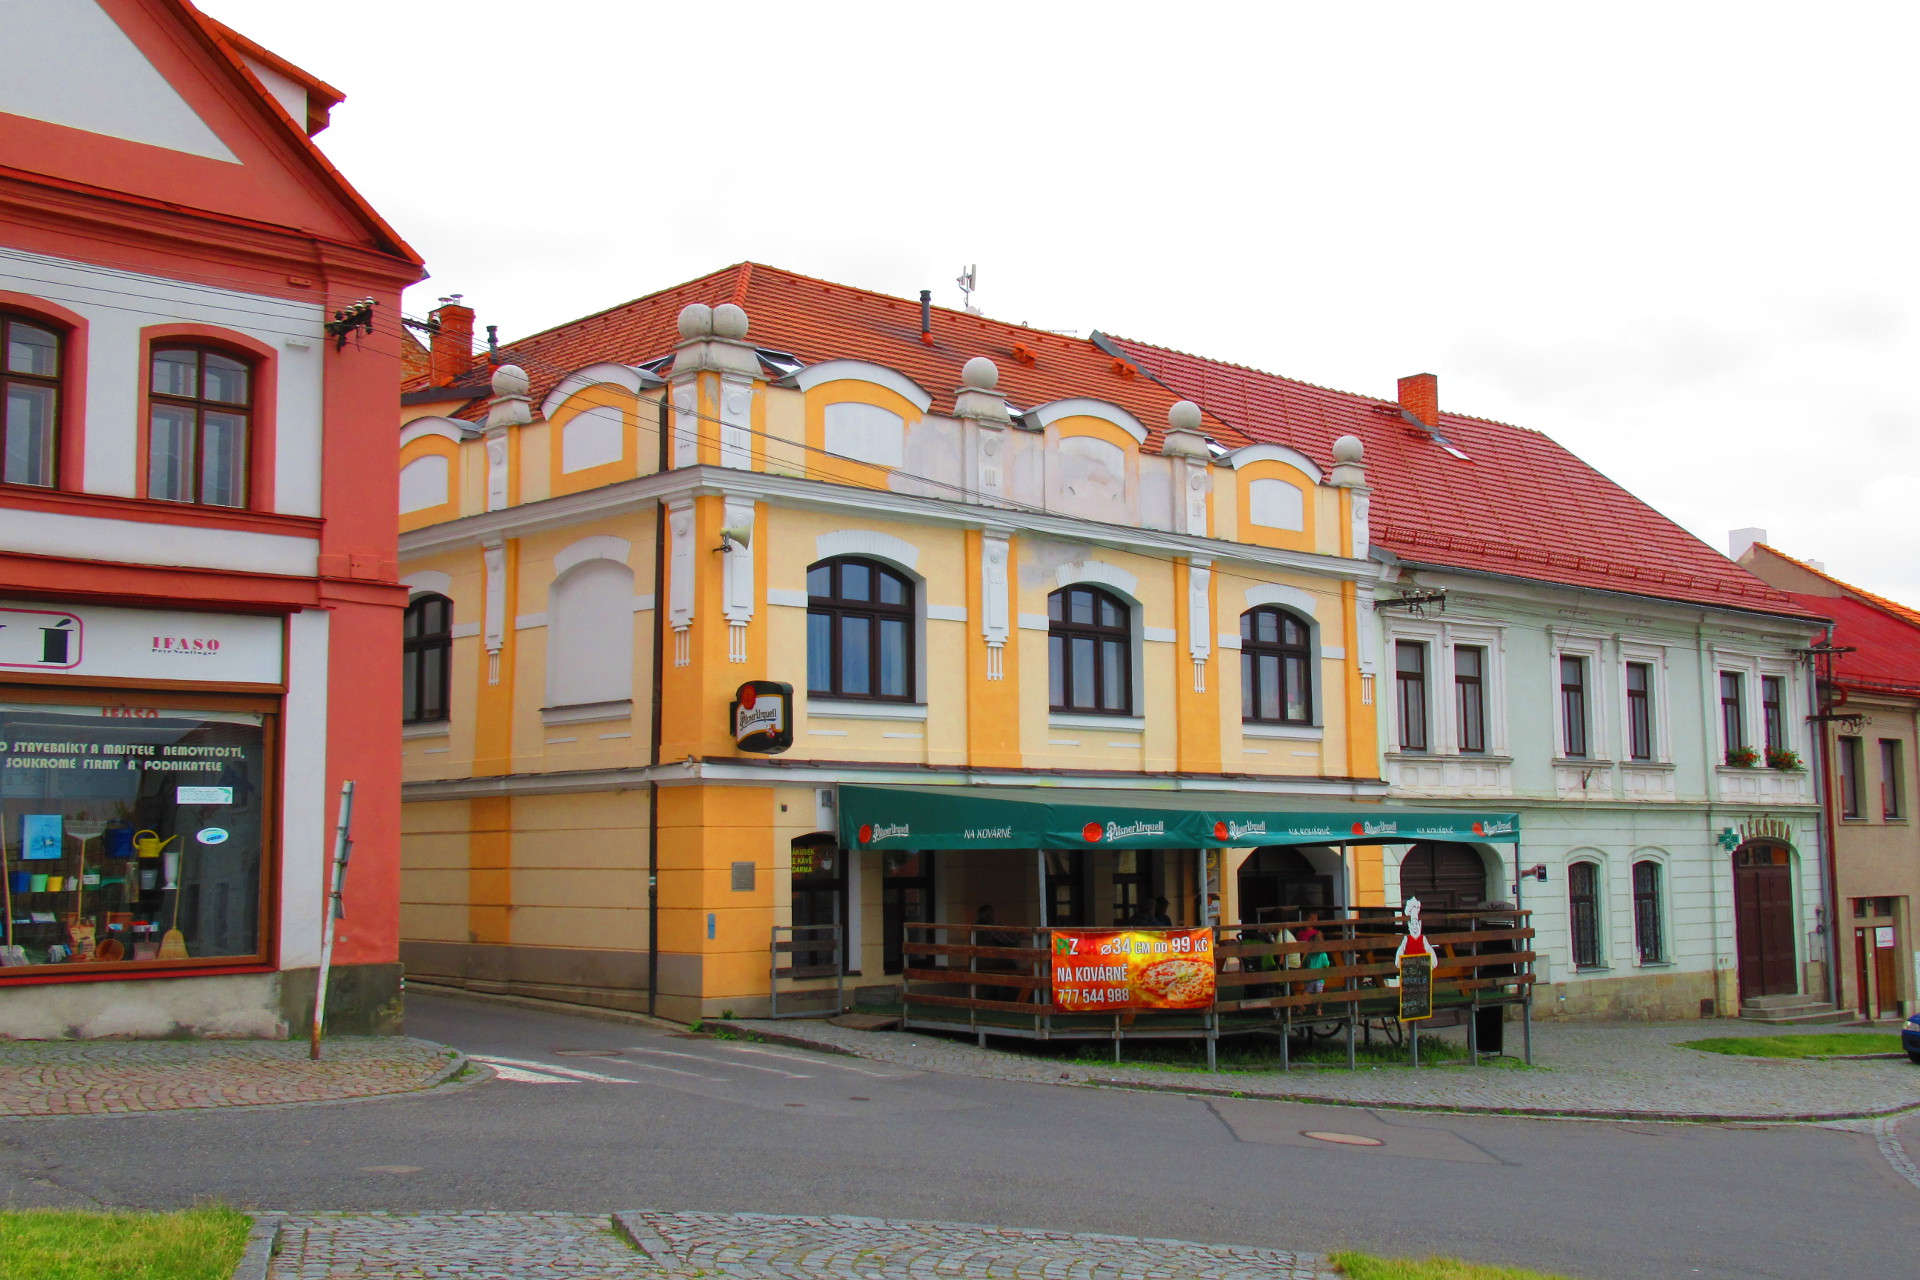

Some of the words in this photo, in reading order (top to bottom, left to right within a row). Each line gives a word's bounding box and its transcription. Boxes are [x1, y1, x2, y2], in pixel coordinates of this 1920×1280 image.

[152, 637, 220, 651] IFASO
[739, 711, 756, 731] Pilsner
[755, 708, 777, 723] Urquell
[13, 741, 88, 753] STAVEBNÍKY
[90, 743, 99, 754] A
[103, 743, 155, 756] MAJITELE
[6, 757, 76, 768] SOUKROMÉ
[83, 759, 120, 769] FIRMY
[128, 760, 136, 770] A
[144, 760, 223, 772] PODNIKATELE
[872, 823, 892, 843] Pilsner
[890, 823, 909, 837] Urquell
[964, 829, 975, 839] NA
[977, 825, 1012, 839] KOVÁRNĚ
[1106, 821, 1136, 842] Pilsner
[1135, 820, 1164, 836] Urquell
[1229, 821, 1248, 840] Pilsner
[1246, 820, 1266, 834] Urquell
[1057, 937, 1097, 955] PIZZA
[1135, 941, 1151, 954] CM
[1154, 941, 1168, 953] OD
[1171, 936, 1191, 953] 99
[1194, 937, 1208, 952] KČ
[1057, 966, 1073, 982] NA
[1076, 964, 1128, 982] KOVÁRNĚ
[1058, 989, 1079, 1004] 777
[1082, 988, 1105, 1003] 544
[1107, 988, 1130, 1002] 988
